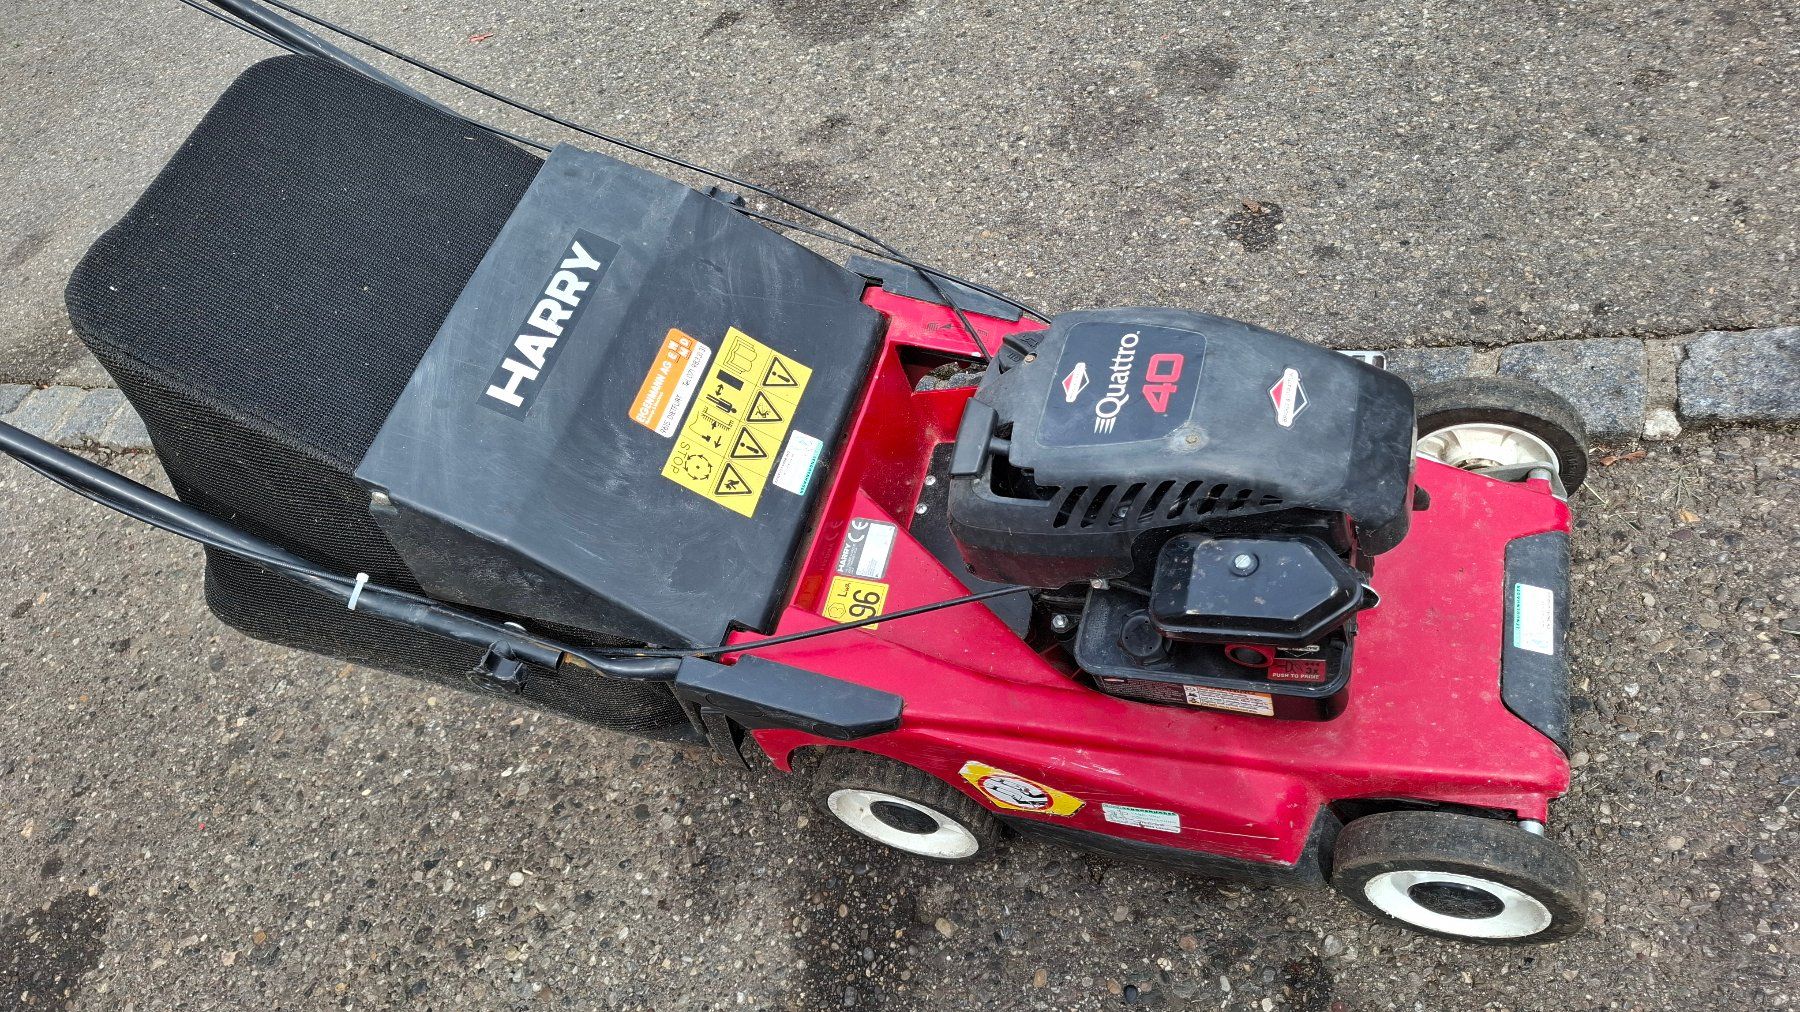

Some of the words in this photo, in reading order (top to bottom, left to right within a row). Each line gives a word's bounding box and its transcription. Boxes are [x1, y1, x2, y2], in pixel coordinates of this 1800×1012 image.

[485, 240, 601, 408] HARRY
[636, 374, 666, 421] EIGENMANN
[660, 360, 673, 376] AG
[1142, 353, 1184, 413] 40
[670, 441, 691, 474] STOP
[837, 543, 851, 573] HARRY
[849, 589, 881, 620] 96
